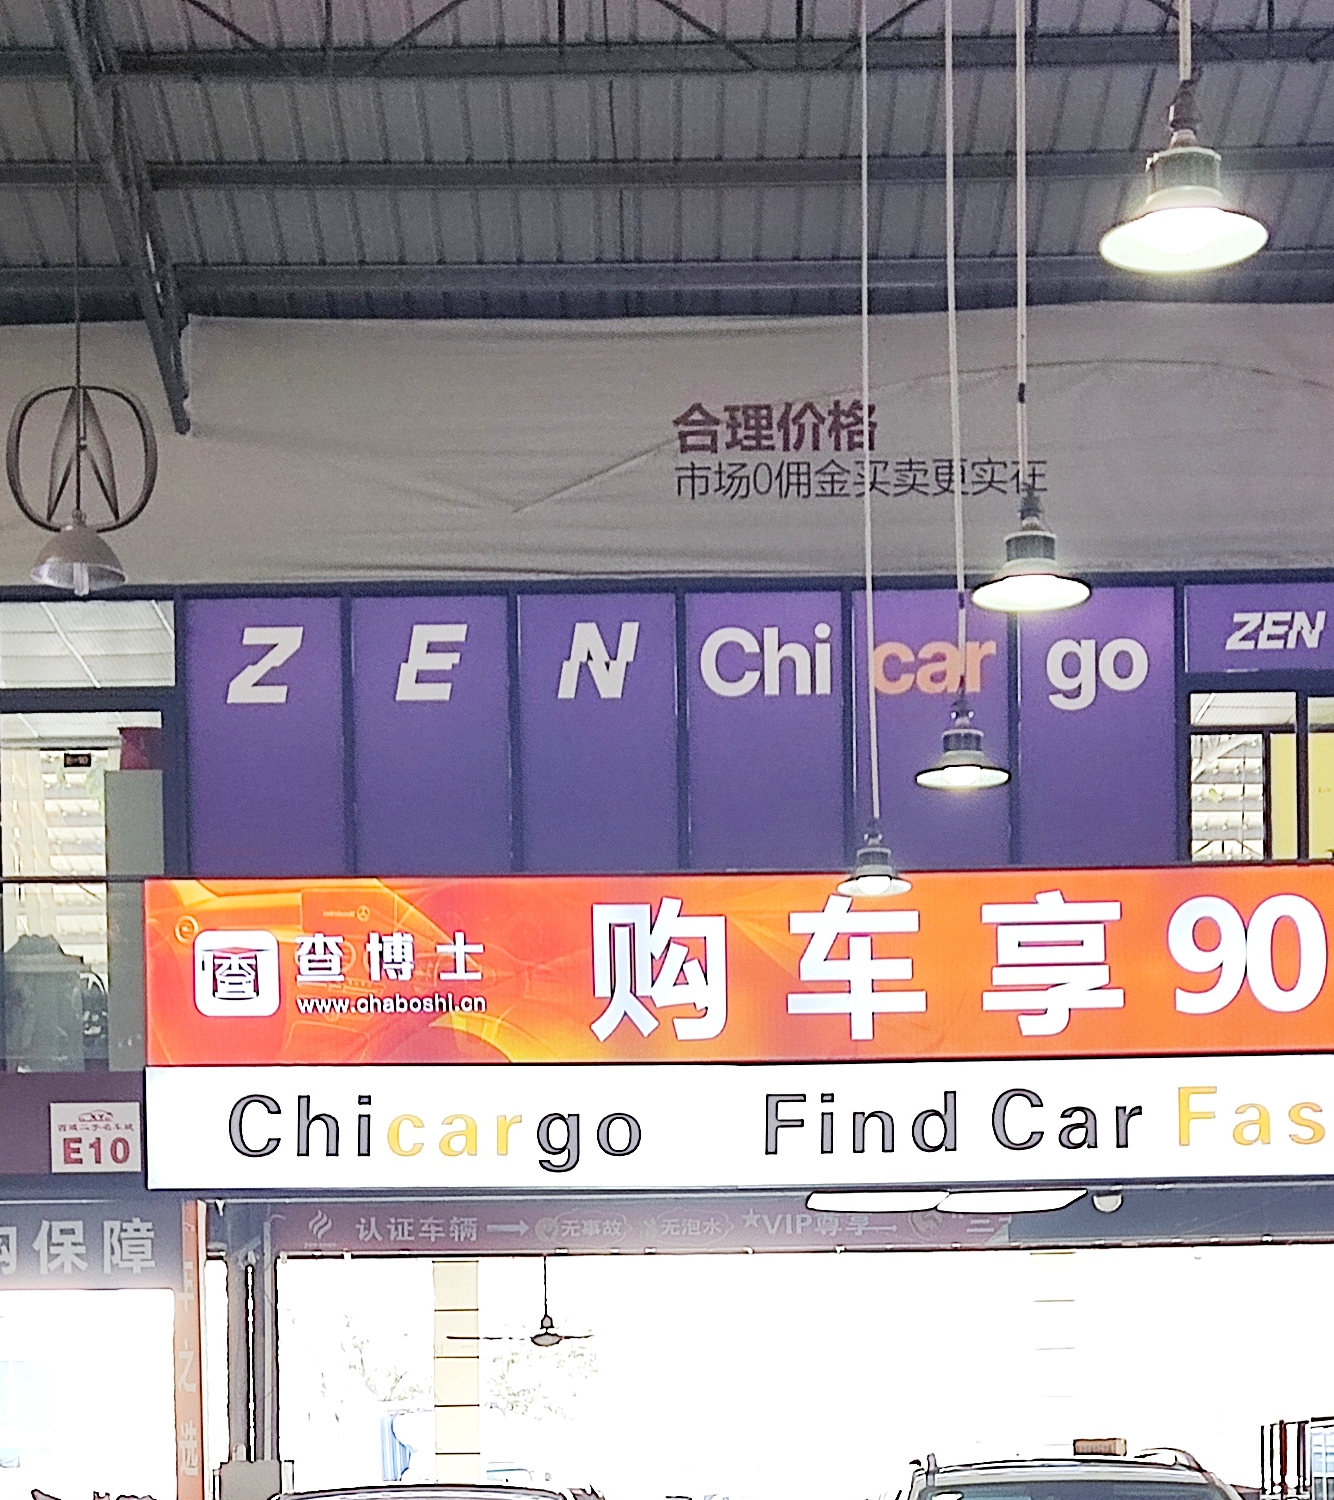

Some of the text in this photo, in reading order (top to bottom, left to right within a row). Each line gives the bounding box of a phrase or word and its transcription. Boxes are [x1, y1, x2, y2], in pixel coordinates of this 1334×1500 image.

[672, 400, 878, 454] 合理价格
[674, 458, 1049, 500] 市场0佣金买卖更实在
[1225, 610, 1327, 651] ZEN
[295, 931, 485, 982] 查博士
[296, 993, 487, 1015] www.chaboshi.cn
[227, 1093, 642, 1173] Chicargo
[761, 1089, 959, 1156] Find
[990, 1087, 1143, 1151] Car
[62, 1136, 131, 1165] E10
[355, 1215, 478, 1243] 认证车辆
[560, 1218, 623, 1238] 无事故
[660, 1217, 723, 1237] 无泡水
